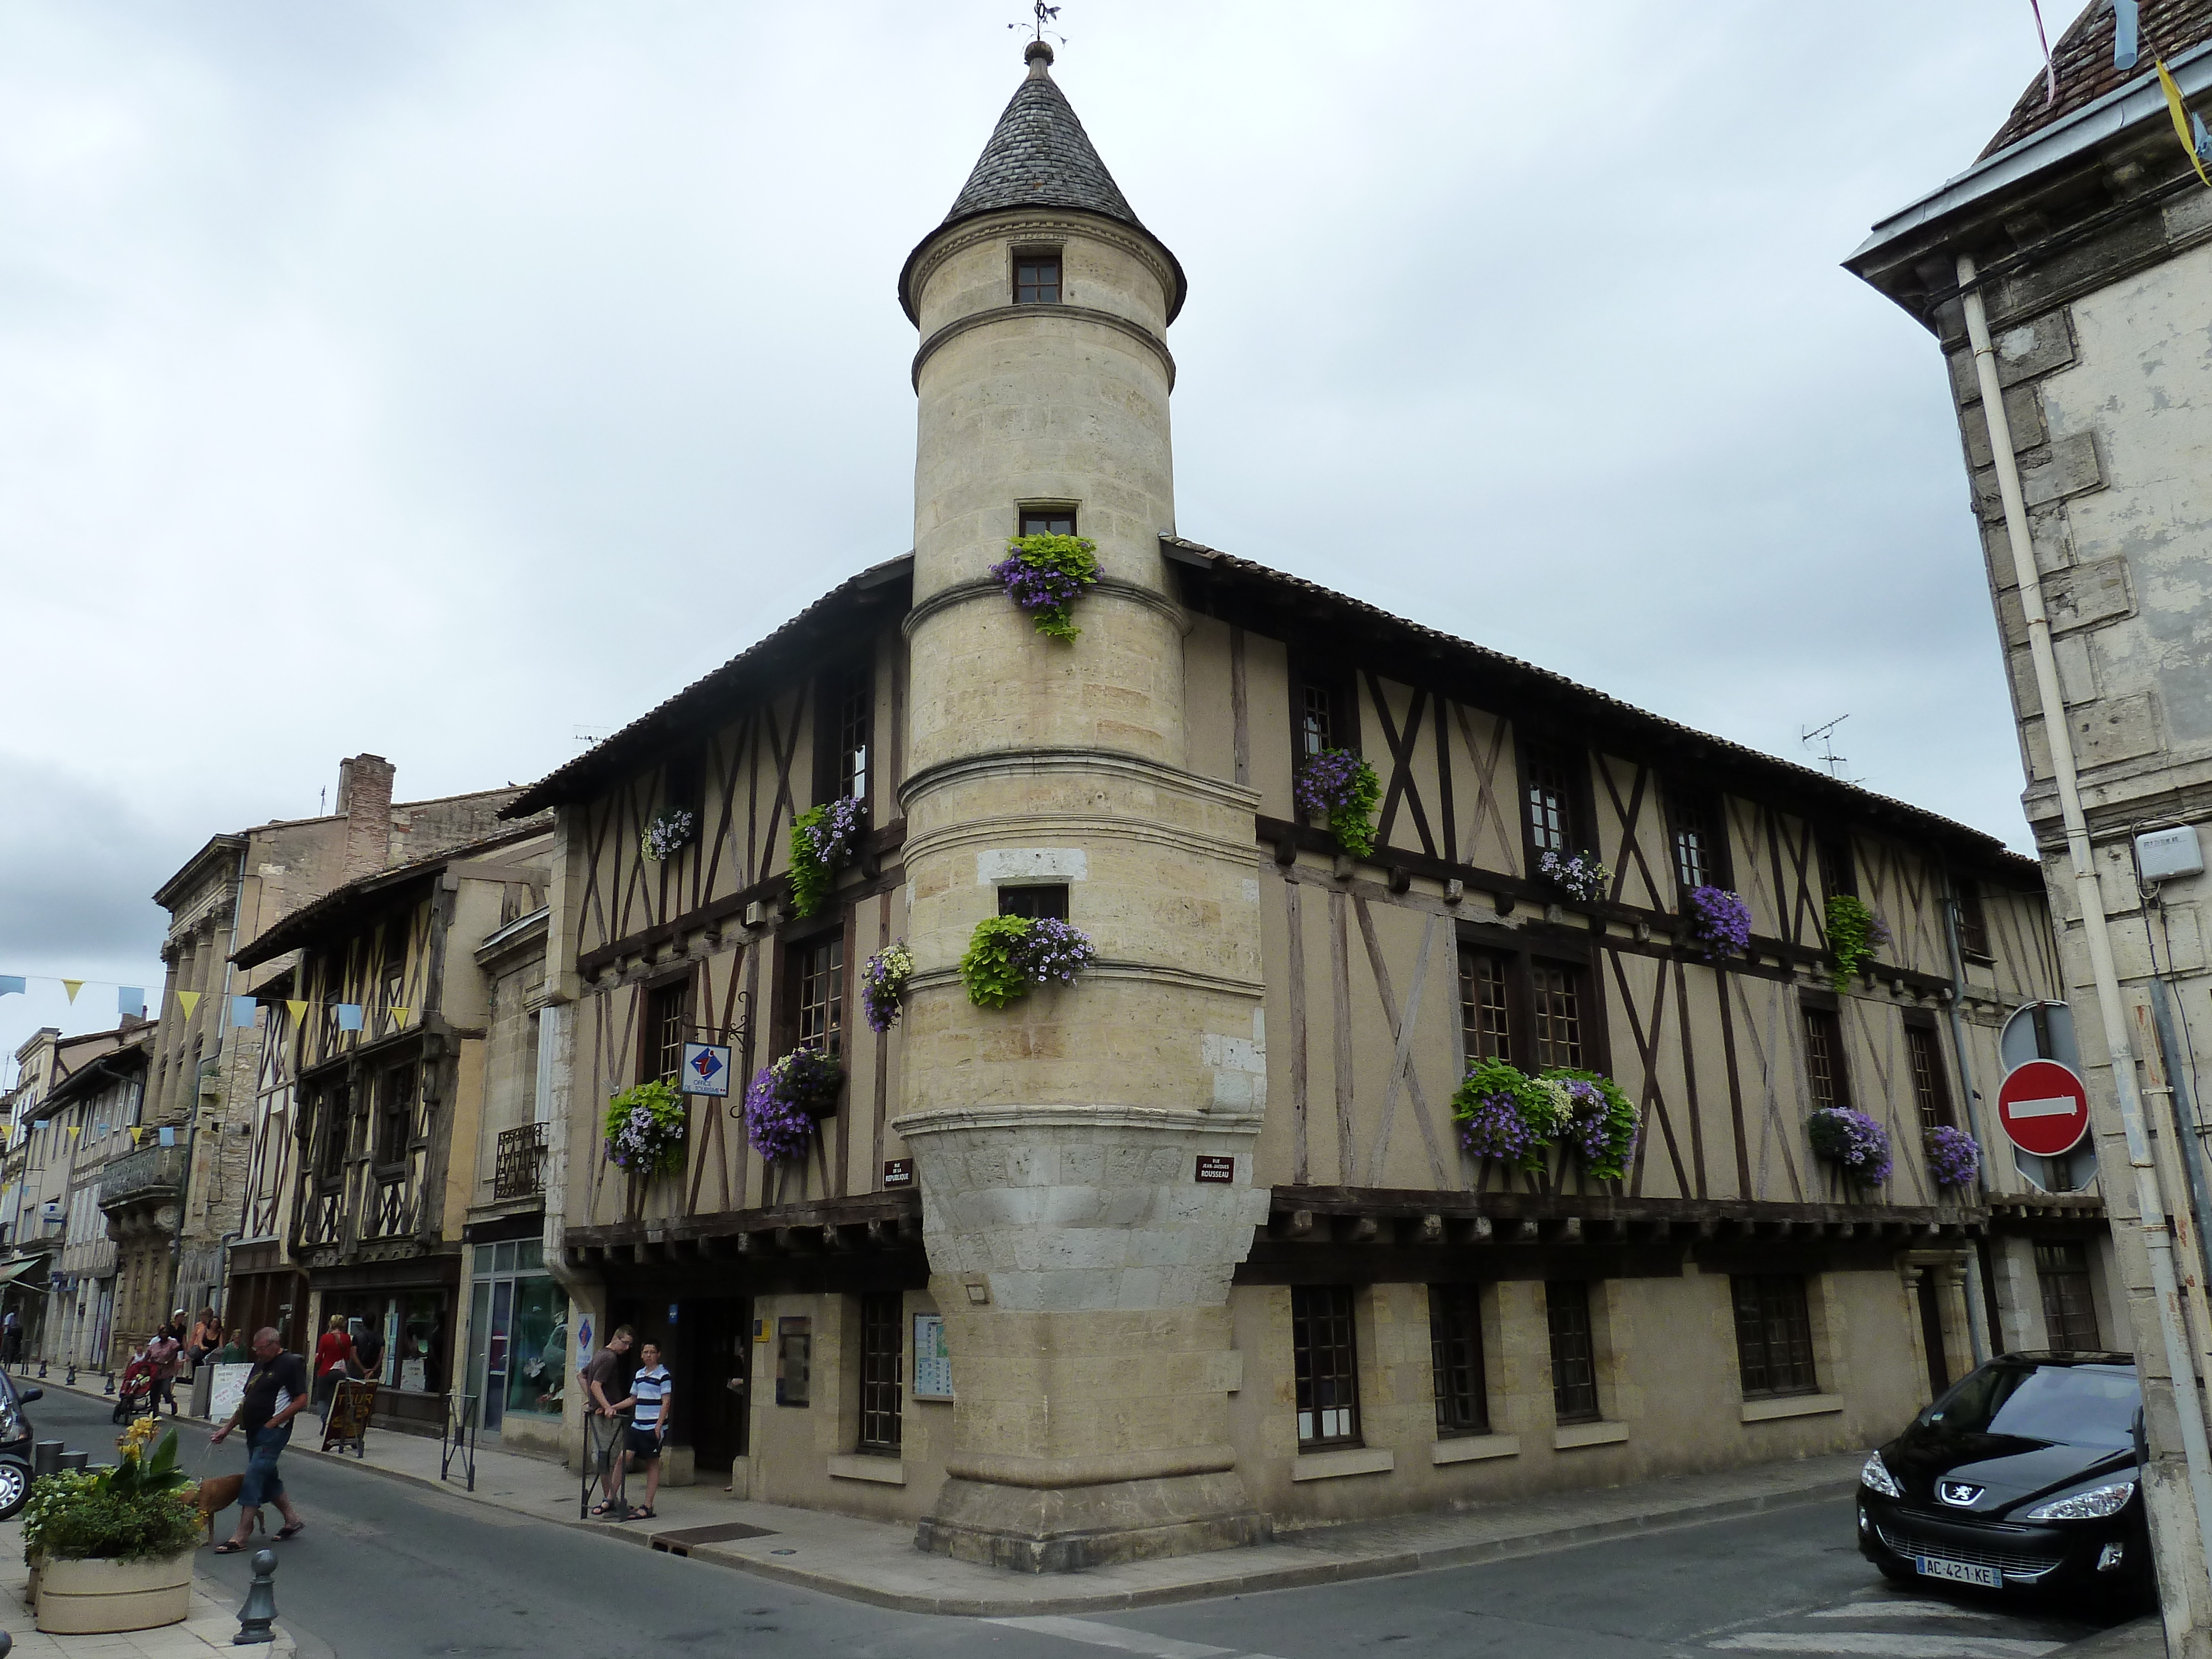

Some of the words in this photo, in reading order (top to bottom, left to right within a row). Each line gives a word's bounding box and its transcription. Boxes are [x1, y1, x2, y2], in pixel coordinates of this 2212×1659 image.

[885, 1173, 909, 1182] REPUBLIQUE
[338, 1394, 374, 1405] TUR
[1927, 1560, 1990, 1583] AC-421-KE
